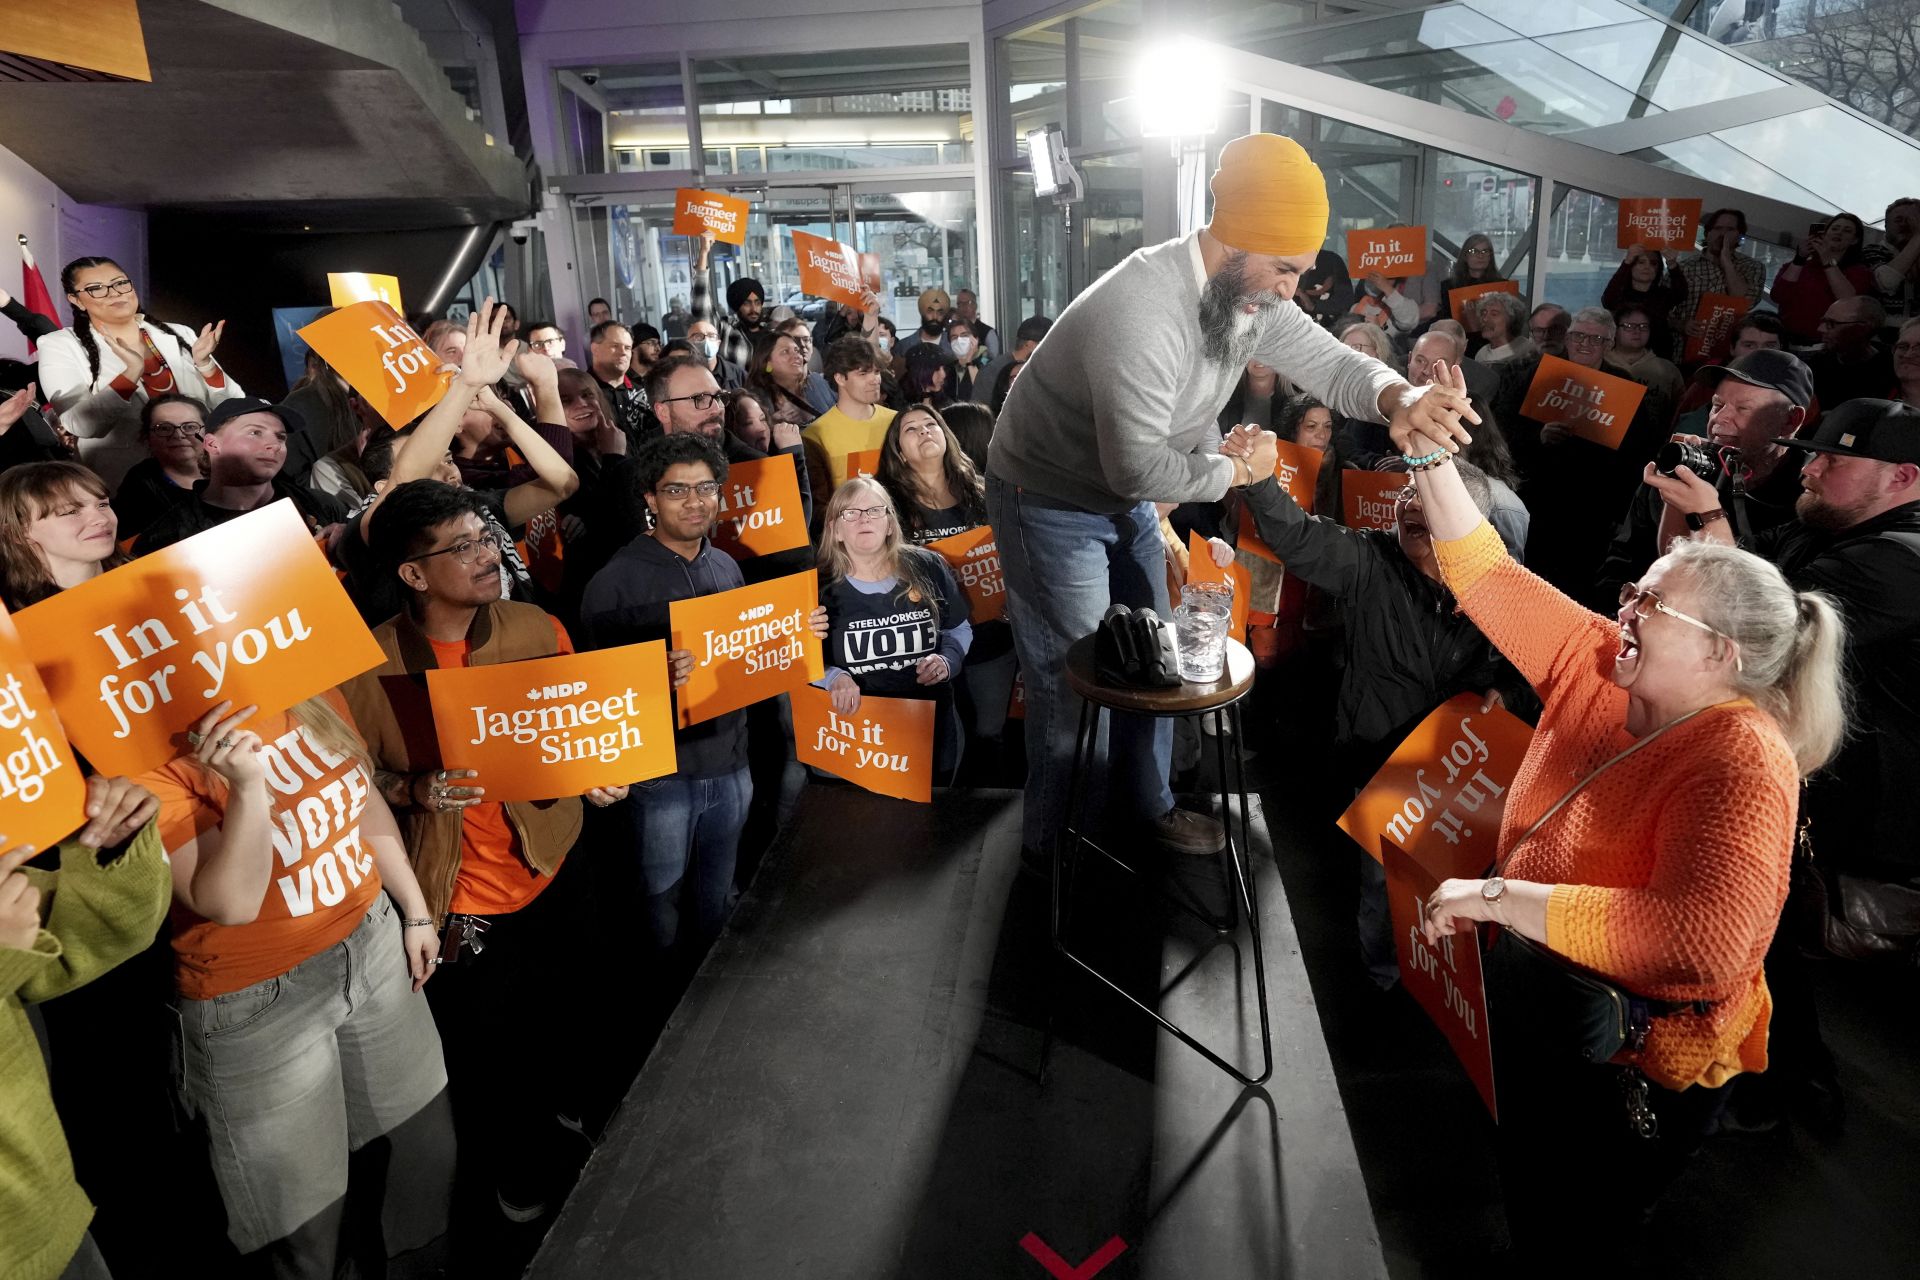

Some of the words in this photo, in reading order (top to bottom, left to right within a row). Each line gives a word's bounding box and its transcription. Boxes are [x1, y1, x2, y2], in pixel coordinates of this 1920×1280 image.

[684, 201, 737, 222] Jagmeet
[702, 215, 736, 233] Singh
[1626, 212, 1687, 229] Jagmeet
[1368, 241, 1386, 253] In
[1389, 239, 1401, 253] it
[1645, 226, 1684, 241] Singh
[1358, 252, 1381, 269] for
[1383, 253, 1414, 269] you
[830, 271, 861, 295] Singh
[369, 322, 416, 349] In
[1697, 305, 1724, 358] Jagmeet
[382, 345, 430, 394] for
[1537, 389, 1573, 410] for
[1570, 404, 1615, 427] you
[1561, 377, 1585, 399] In
[1588, 385, 1605, 406] it
[733, 484, 757, 509] it
[731, 506, 784, 541] you
[94, 617, 179, 670] In
[174, 585, 238, 636] it
[748, 603, 775, 621] NDP
[848, 608, 931, 630] STEELWORKERS
[700, 608, 803, 668] Jagmeet
[745, 636, 805, 675] Singh
[845, 619, 937, 663] VOTE
[99, 664, 176, 739] for
[191, 607, 312, 699] you
[543, 681, 588, 700] NDP
[470, 687, 640, 745] Jagmeet
[828, 710, 856, 740] In
[862, 719, 884, 746] it
[540, 720, 643, 764] Singh
[813, 726, 851, 756] for
[855, 747, 909, 772] you
[1440, 717, 1489, 784] for
[1386, 768, 1442, 844] you
[1454, 768, 1505, 812] In
[1431, 808, 1473, 845] it
[1409, 924, 1439, 981] for
[1443, 969, 1478, 1039] you
